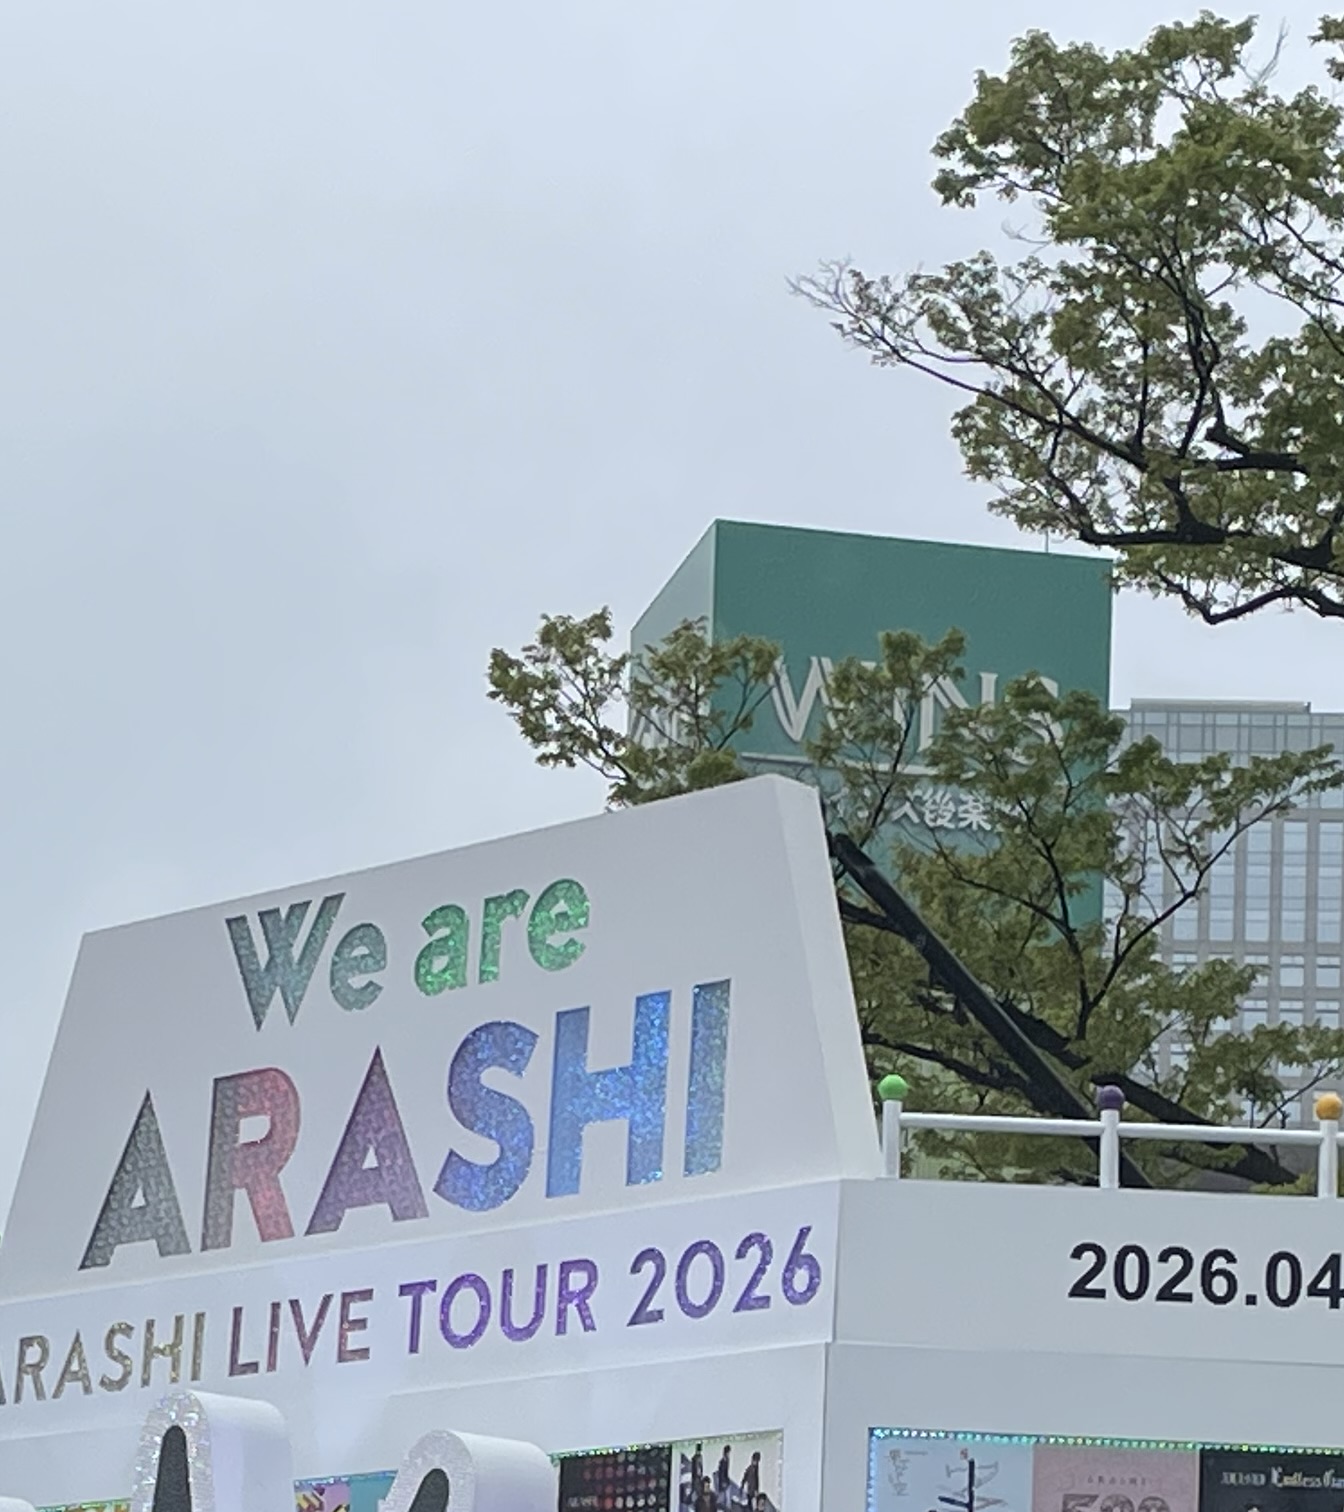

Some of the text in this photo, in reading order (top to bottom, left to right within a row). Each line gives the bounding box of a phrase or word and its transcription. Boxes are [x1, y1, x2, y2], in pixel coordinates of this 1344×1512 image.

[226, 877, 591, 1030] We are
[78, 979, 732, 1271] ARASHI
[228, 1288, 372, 1377] LIVE
[399, 1258, 599, 1354] TOUR
[627, 1226, 822, 1327] 2026
